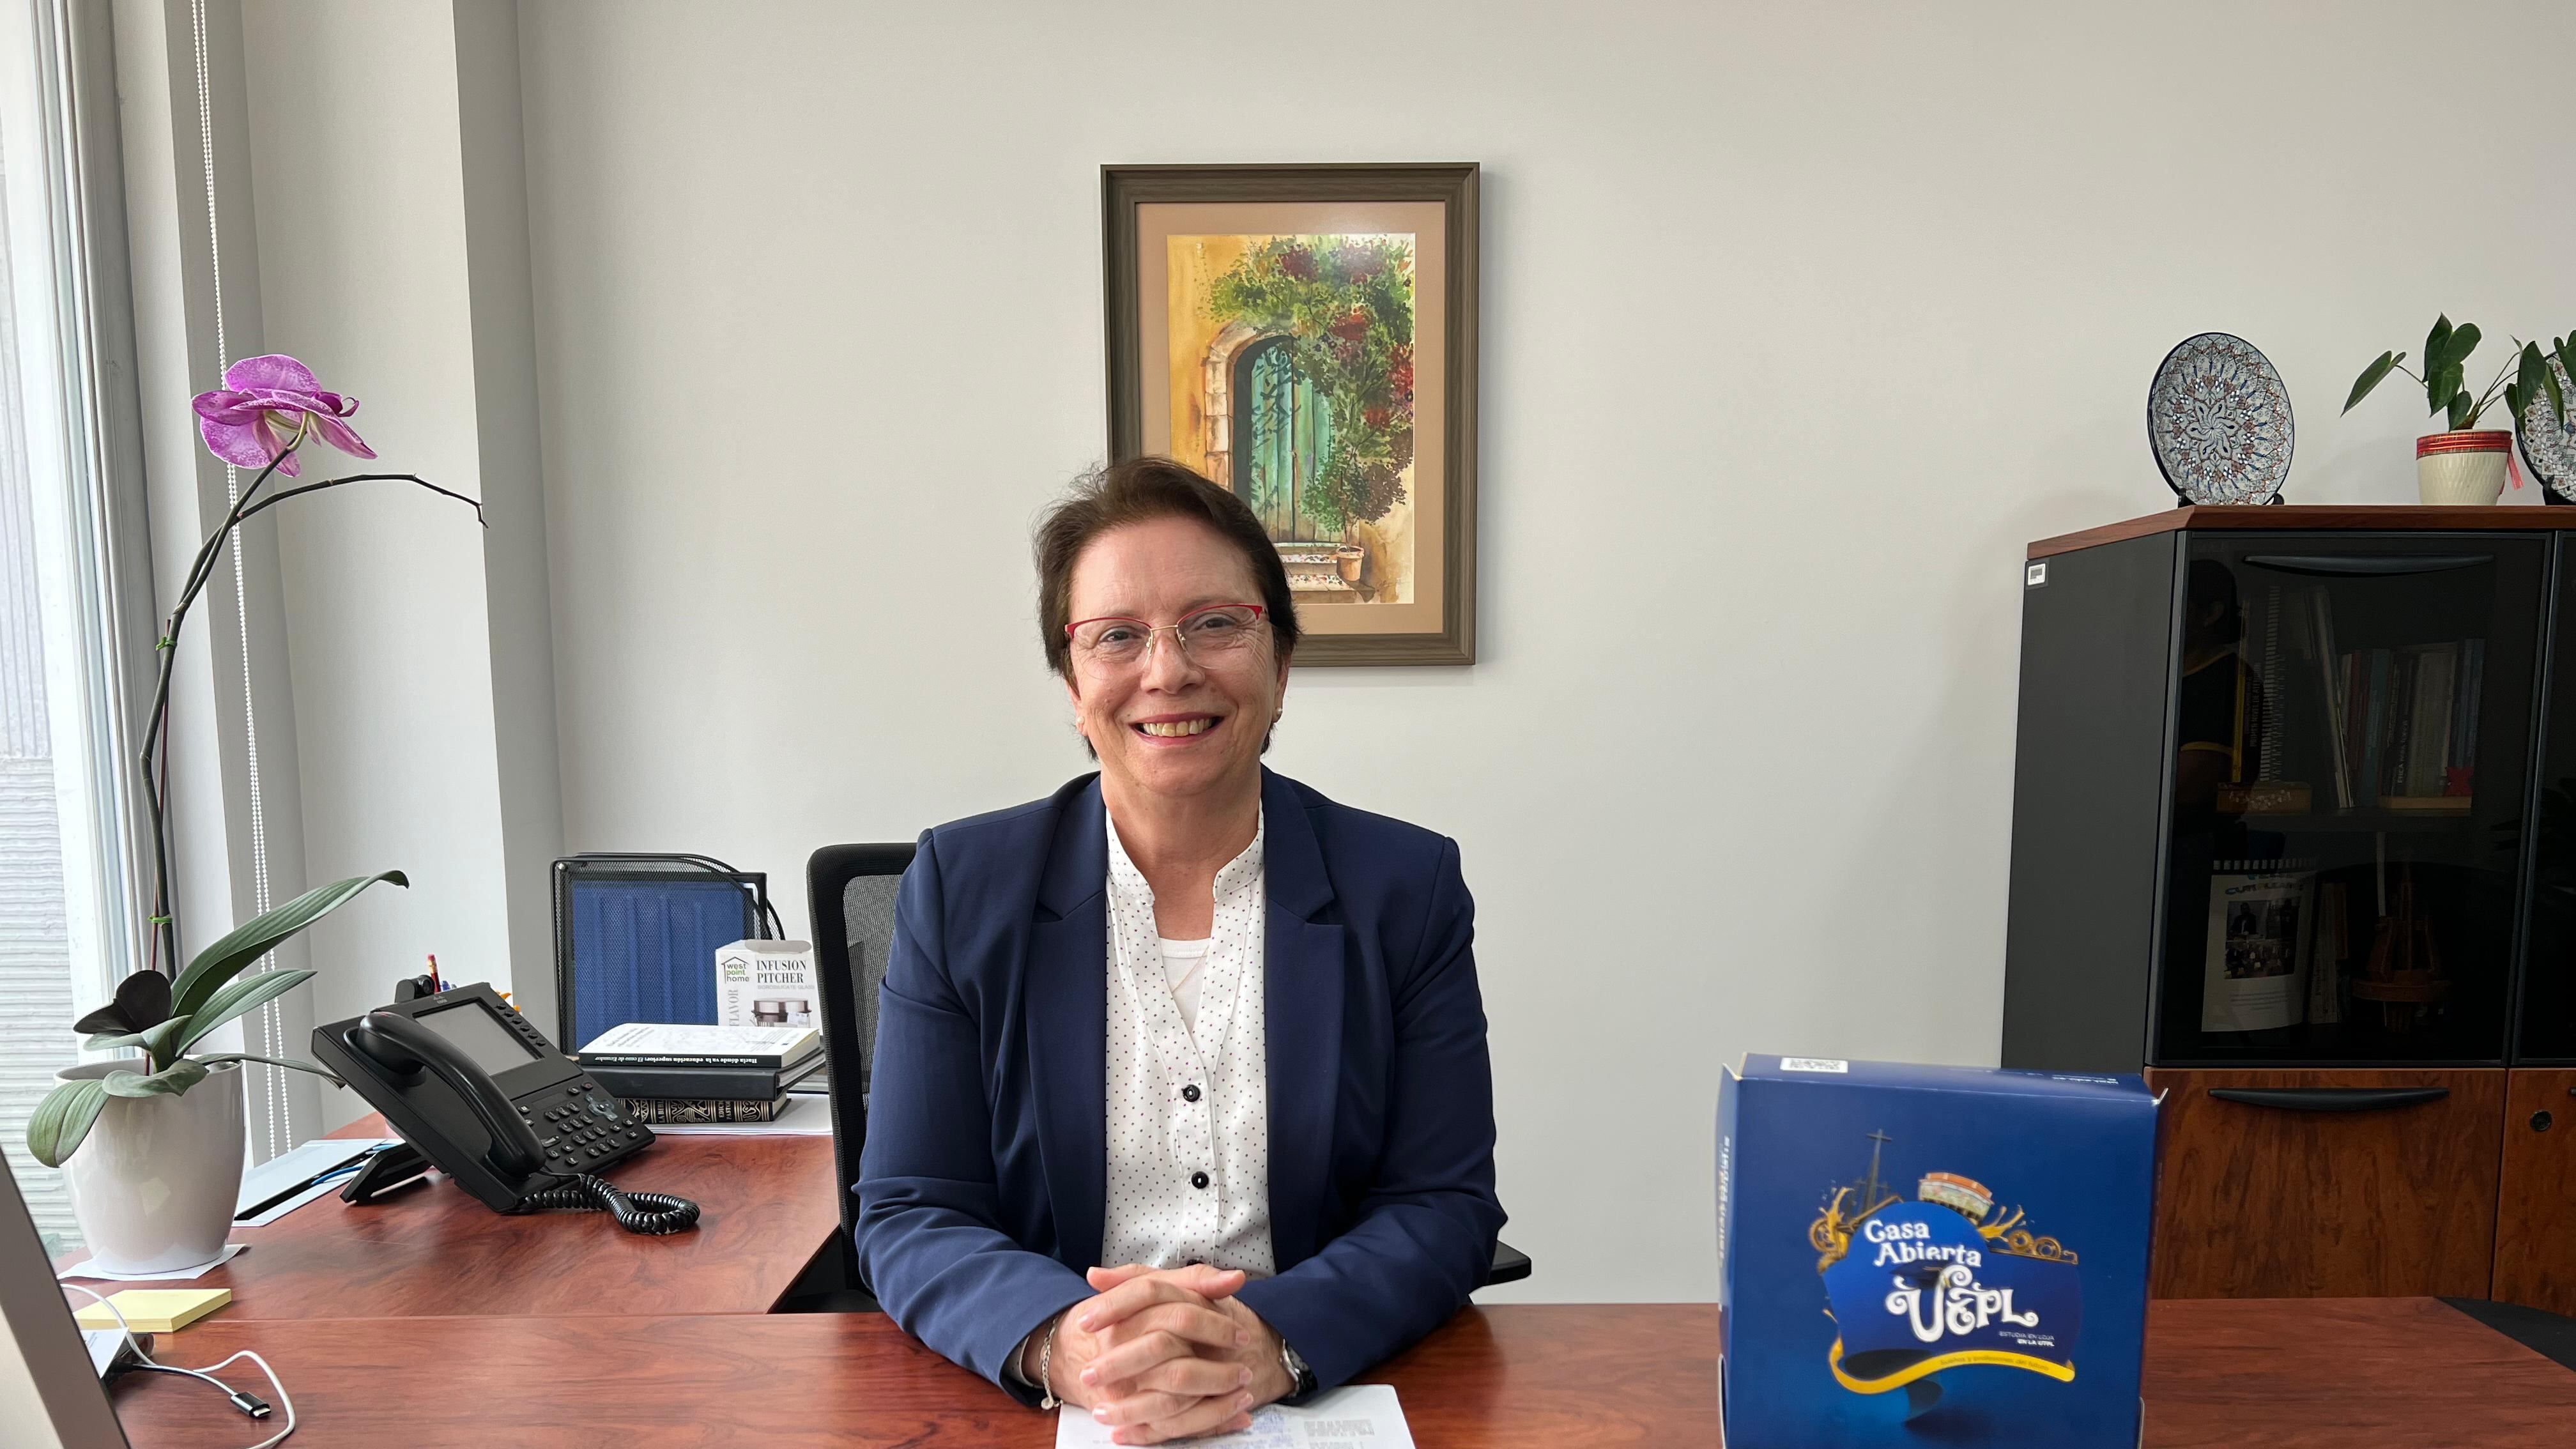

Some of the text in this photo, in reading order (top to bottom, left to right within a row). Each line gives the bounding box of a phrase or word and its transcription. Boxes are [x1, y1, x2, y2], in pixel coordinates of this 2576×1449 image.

[756, 960, 806, 970] INFUSION
[757, 972, 804, 983] PITCHER
[728, 989, 739, 1026] FLAVOR
[1864, 1219, 1930, 1243] Casa
[1873, 1242, 1981, 1267] Abierta
